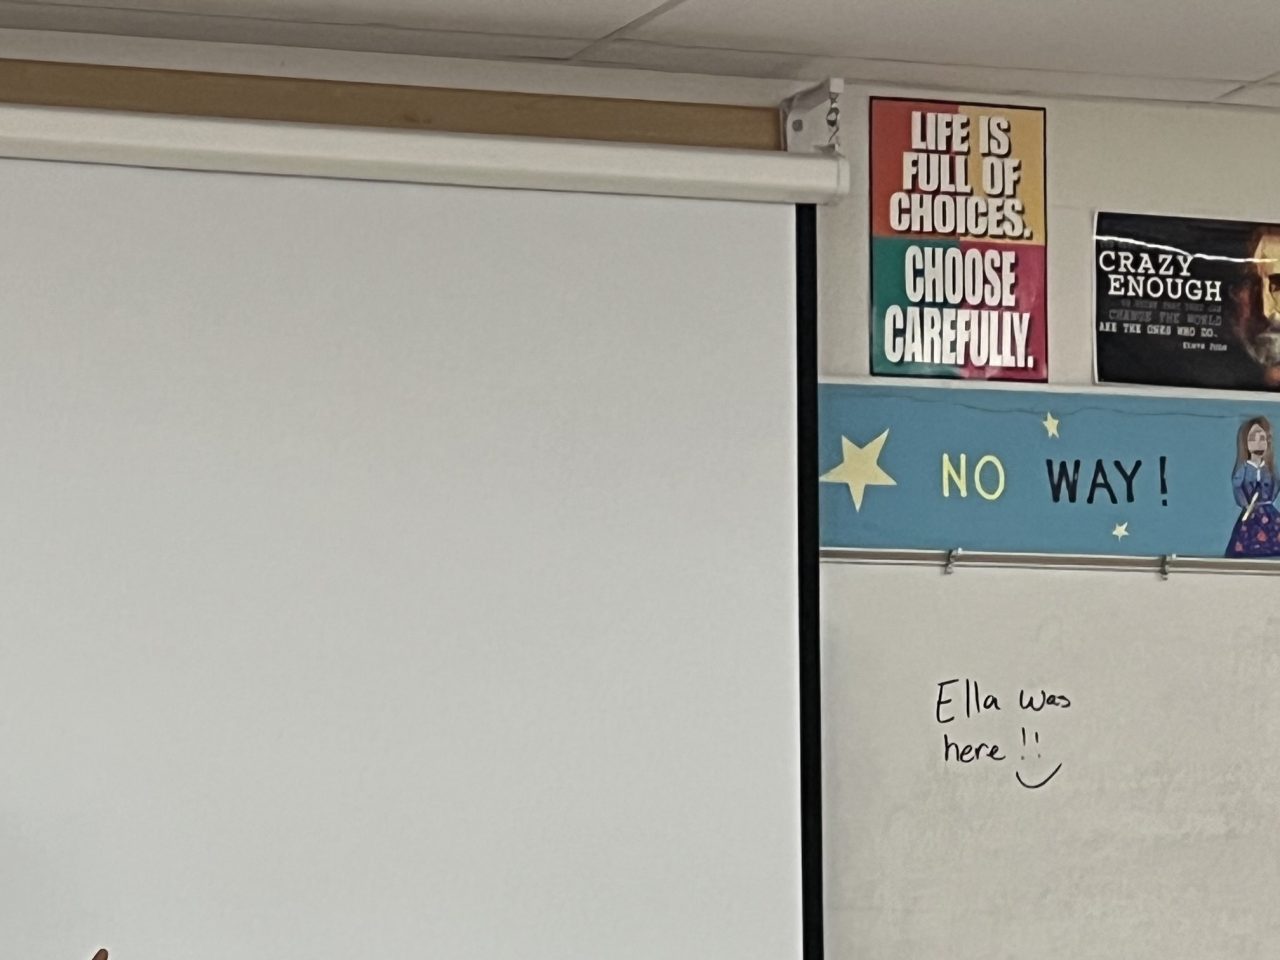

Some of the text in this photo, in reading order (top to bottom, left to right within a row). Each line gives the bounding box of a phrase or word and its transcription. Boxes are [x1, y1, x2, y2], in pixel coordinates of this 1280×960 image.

[911, 110, 1011, 156] LIFE IS
[903, 152, 1021, 198] FULL OF
[889, 191, 1033, 238] CHOICES.
[905, 245, 1017, 307] CHOOSE
[1099, 251, 1194, 276] CRAZY
[1108, 274, 1222, 302] ENOUGH
[884, 304, 1035, 368] CAREFULLY.
[942, 453, 1006, 501] NO
[935, 678, 1000, 723] Ella
[944, 733, 1007, 764] here
